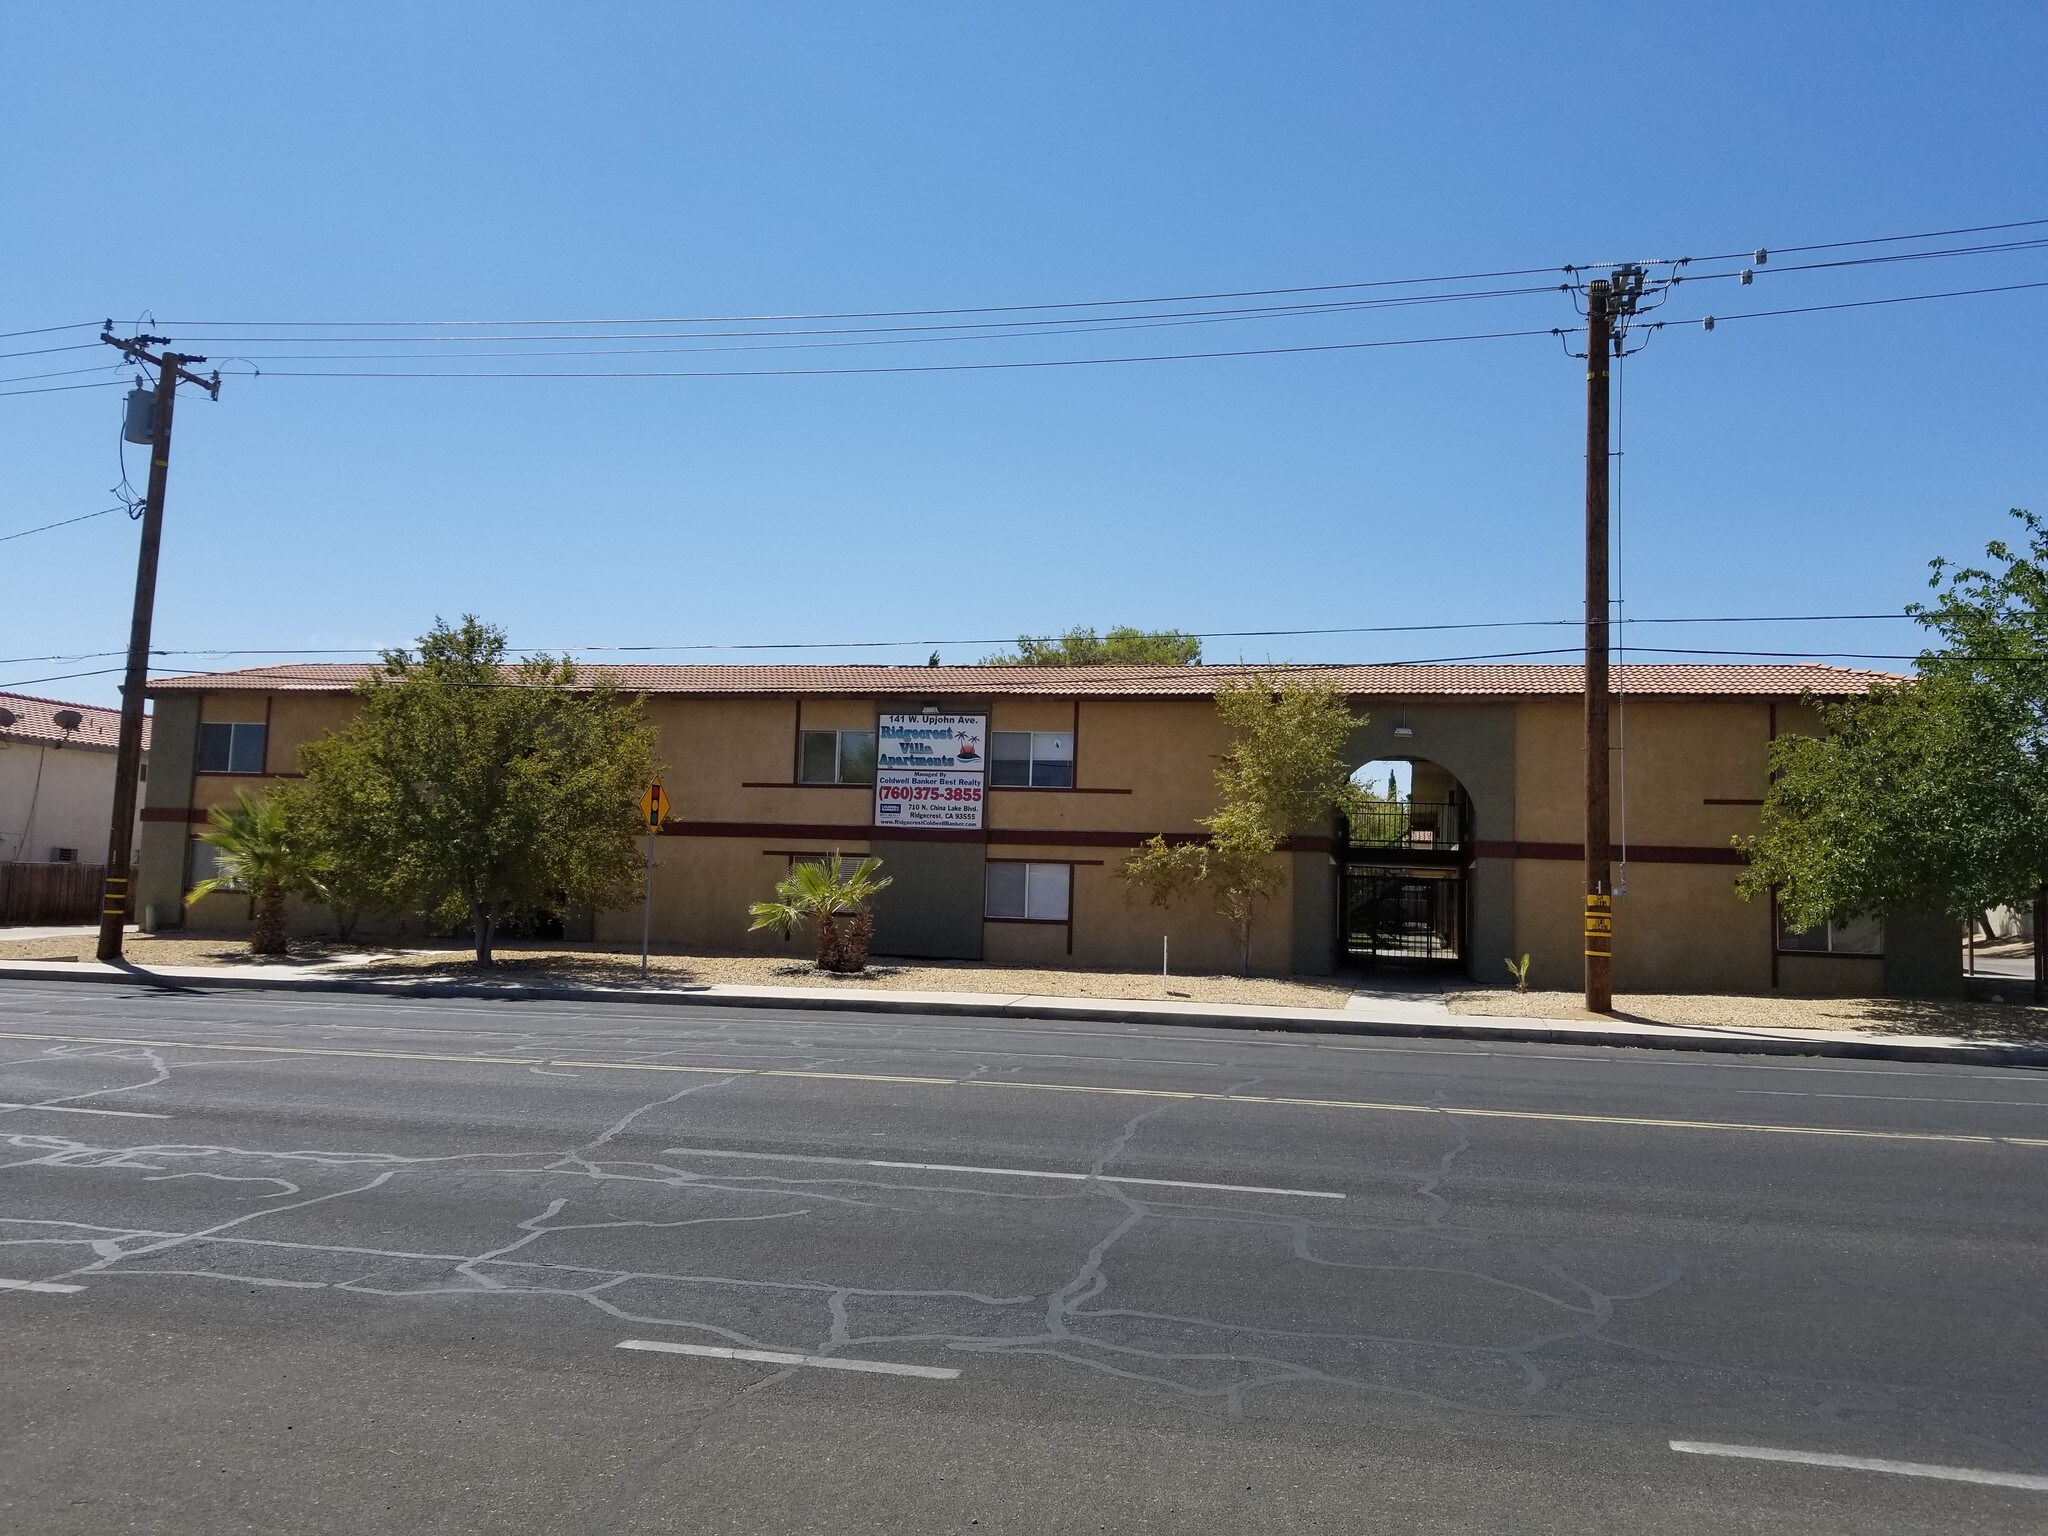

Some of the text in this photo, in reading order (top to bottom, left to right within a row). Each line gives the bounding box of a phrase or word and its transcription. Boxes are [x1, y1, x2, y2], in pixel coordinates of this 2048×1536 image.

[889, 715, 978, 725] 141 W. Upjohn Ave.
[881, 725, 953, 742] Ridgecrest
[899, 742, 934, 755] Villa
[879, 754, 955, 768] Apartments
[959, 779, 981, 787] Realty
[879, 785, 982, 801] (760)375-3855
